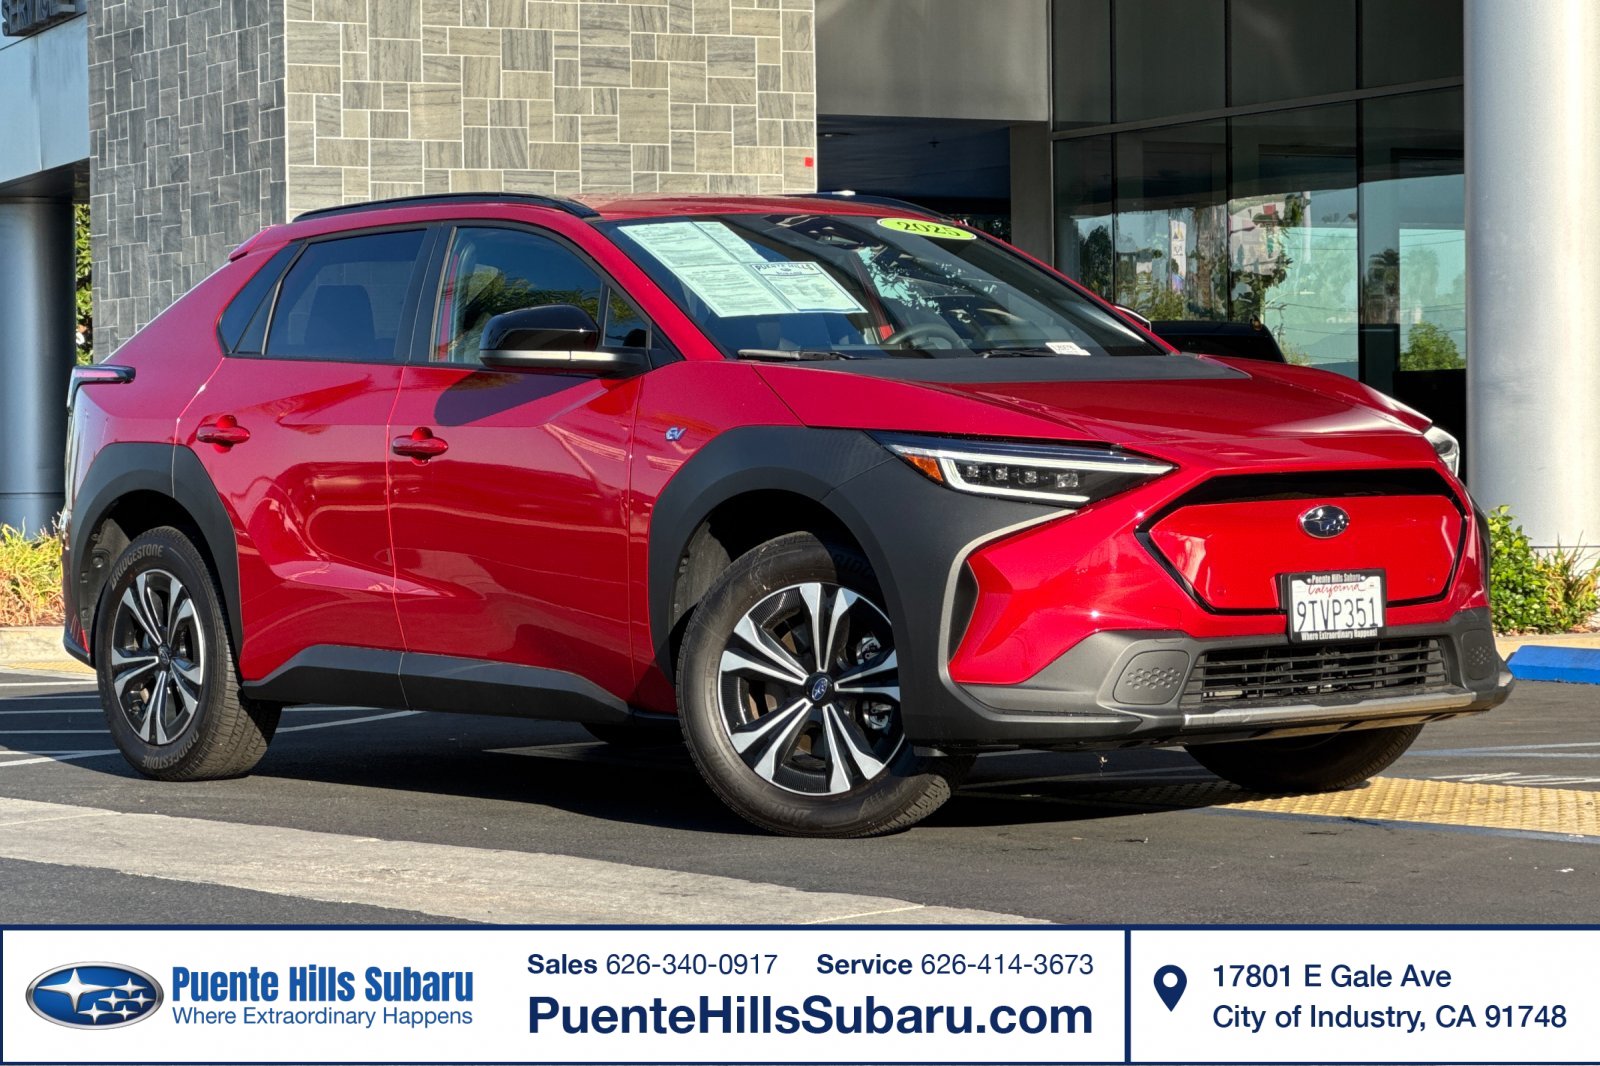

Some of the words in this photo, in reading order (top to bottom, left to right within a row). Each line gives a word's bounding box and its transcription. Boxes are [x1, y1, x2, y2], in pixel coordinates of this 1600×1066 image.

[896, 221, 961, 237] 2025
[110, 543, 164, 592] BRIDGESTONE
[1311, 574, 1331, 584] Puente
[1331, 573, 1343, 583] Hills
[1343, 572, 1361, 582] Subaru
[1307, 583, 1366, 598] California
[1296, 597, 1379, 632] 9TVP351
[1301, 631, 1319, 641] Where
[1319, 630, 1354, 641] Extraordinary
[140, 729, 200, 771] BRIDGESTONE
